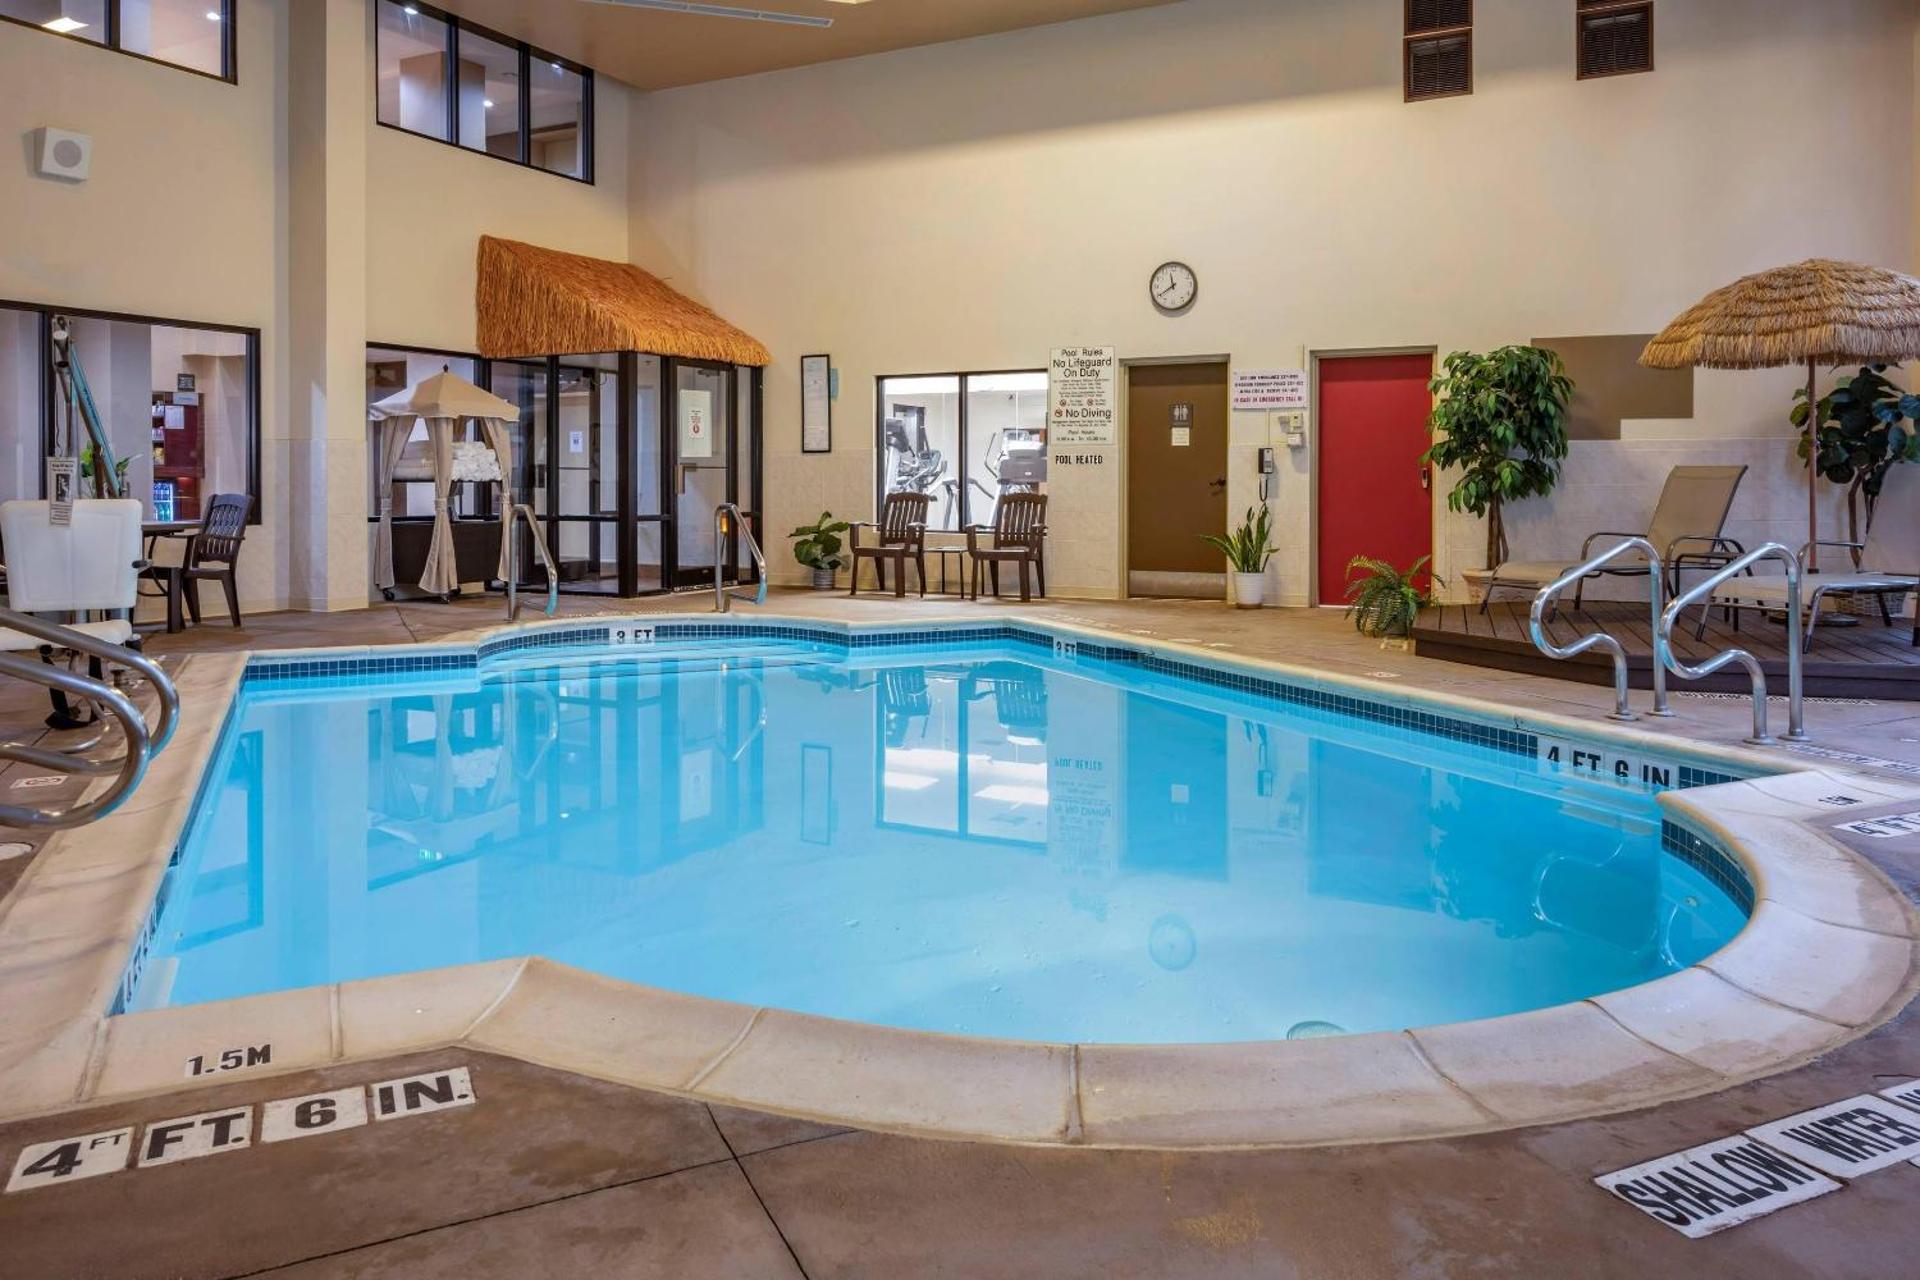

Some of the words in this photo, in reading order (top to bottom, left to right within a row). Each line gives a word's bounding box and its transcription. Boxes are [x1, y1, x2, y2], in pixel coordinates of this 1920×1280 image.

[1062, 349, 1076, 357] Pool
[1082, 348, 1103, 356] Rules
[1053, 359, 1066, 368] No
[1068, 356, 1112, 370] Lifeguard
[1063, 368, 1077, 378] On
[1079, 368, 1100, 379] Duty
[1065, 408, 1080, 418] No
[1081, 407, 1112, 420] Diving
[1055, 454, 1071, 465] POOL
[1075, 454, 1103, 465] HEATED
[1547, 745, 1560, 763] 4
[1572, 750, 1602, 771] FT
[1642, 764, 1670, 787] IN
[187, 1045, 271, 1076] 1.5M
[22, 1141, 83, 1178] 4
[146, 1111, 246, 1161] FT.
[295, 1098, 337, 1129] 6
[378, 1074, 469, 1116] IN.
[1613, 1142, 1817, 1227] SHALLOW
[1780, 1107, 1920, 1164] WATER
